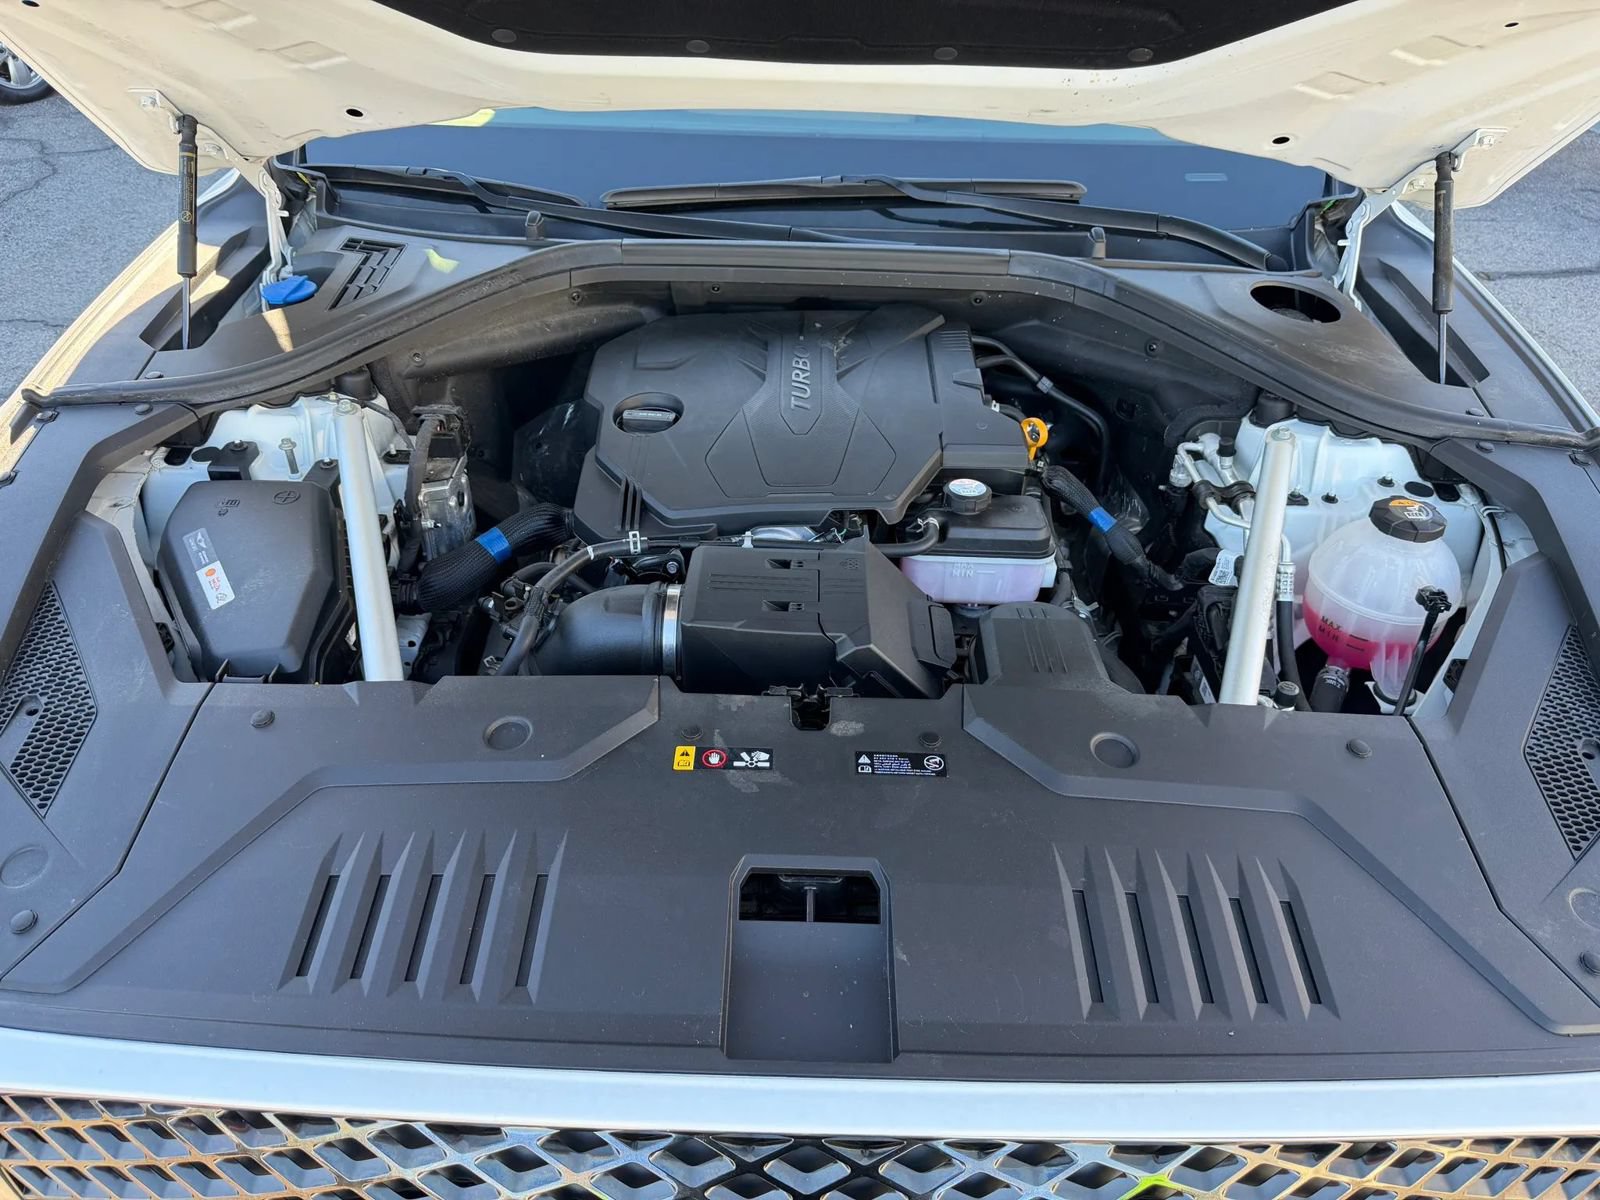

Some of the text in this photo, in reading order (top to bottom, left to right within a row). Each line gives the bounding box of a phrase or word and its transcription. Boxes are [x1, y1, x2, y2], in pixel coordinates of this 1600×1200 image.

[790, 345, 811, 411] TURBO
[952, 569, 975, 578] MIN
[1321, 616, 1342, 632] MAX
[1318, 625, 1340, 642] MIN
